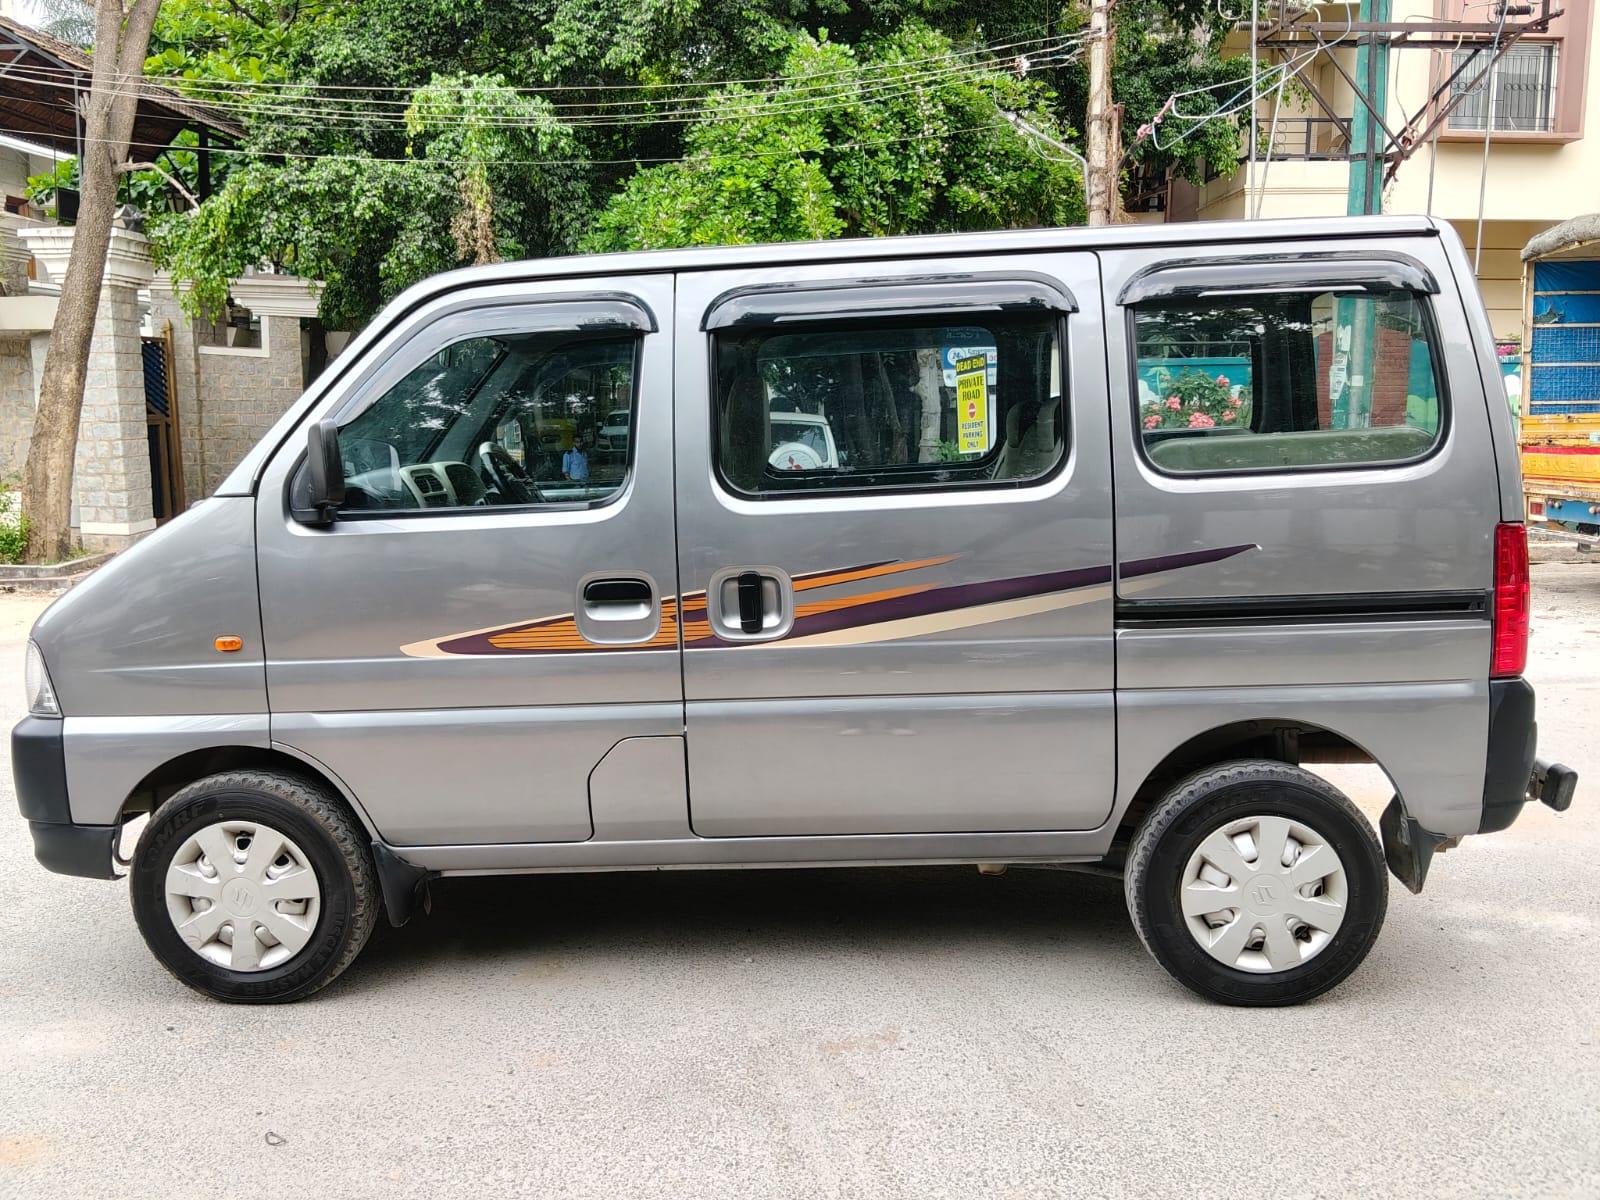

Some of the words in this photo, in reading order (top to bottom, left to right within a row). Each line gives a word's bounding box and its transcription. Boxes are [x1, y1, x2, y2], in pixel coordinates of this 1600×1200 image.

[956, 359, 973, 372] DEAD
[973, 357, 984, 368] END
[958, 376, 984, 390] PRIVATE
[962, 389, 980, 401] ROAD
[962, 421, 983, 429] RESIDENT
[963, 431, 983, 439] PARKING
